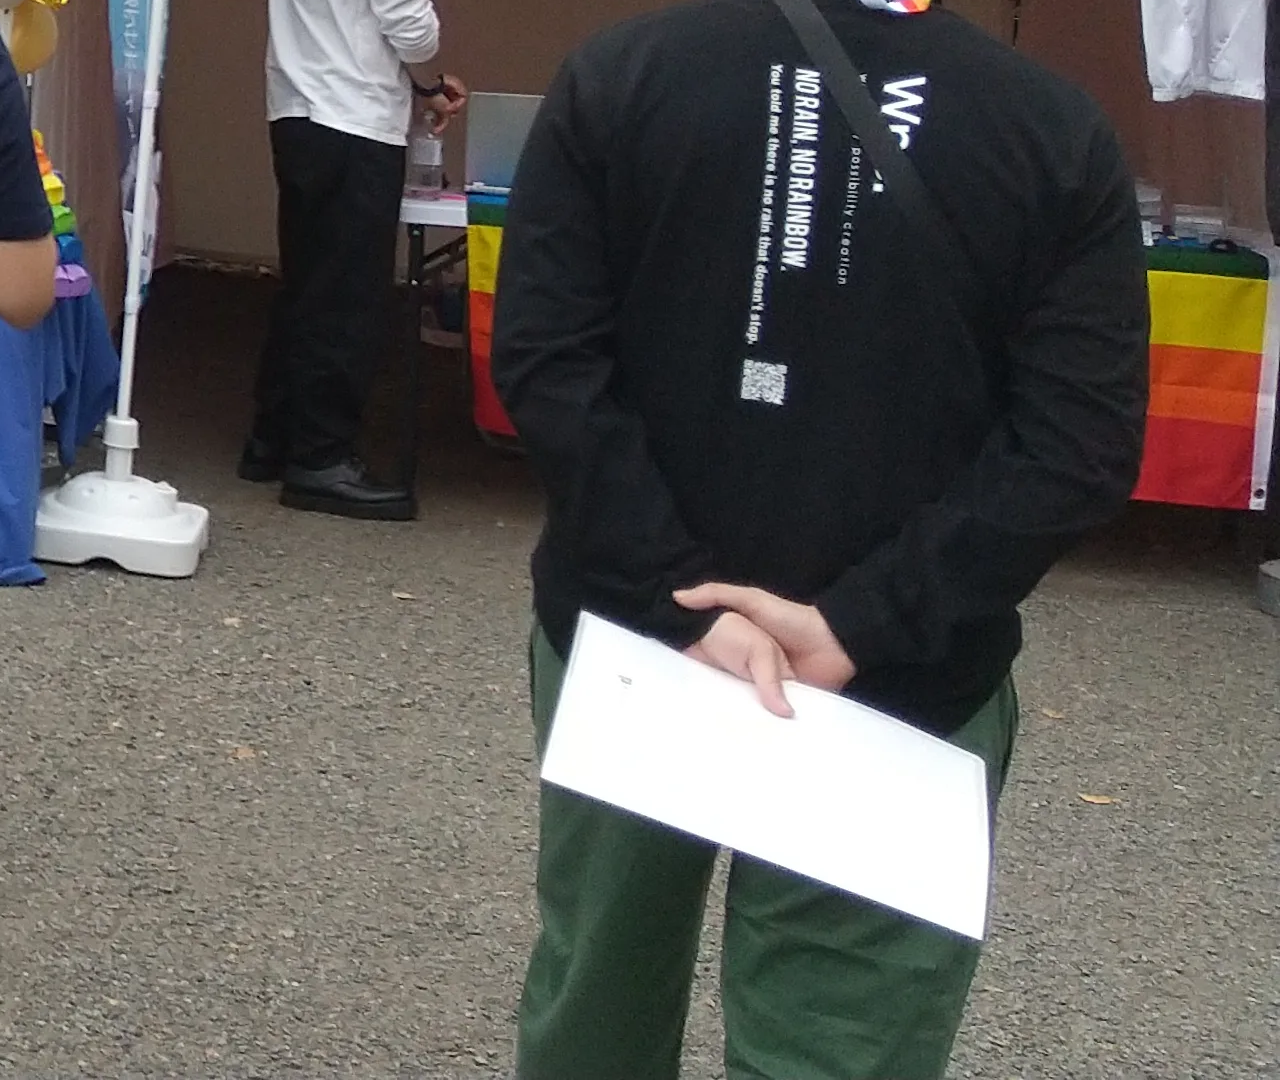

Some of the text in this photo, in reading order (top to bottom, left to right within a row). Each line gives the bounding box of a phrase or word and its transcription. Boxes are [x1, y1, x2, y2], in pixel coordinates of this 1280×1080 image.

[769, 63, 785, 86] You
[768, 88, 783, 112] told
[768, 115, 780, 134] me
[765, 137, 781, 171] there
[763, 174, 777, 186] is
[779, 67, 822, 272] NO RAIN, NO RAINBOW.
[761, 188, 774, 205] no
[759, 207, 775, 233] rain
[837, 146, 862, 286] possibility creation
[756, 236, 772, 262] that
[749, 264, 769, 311] doesn't
